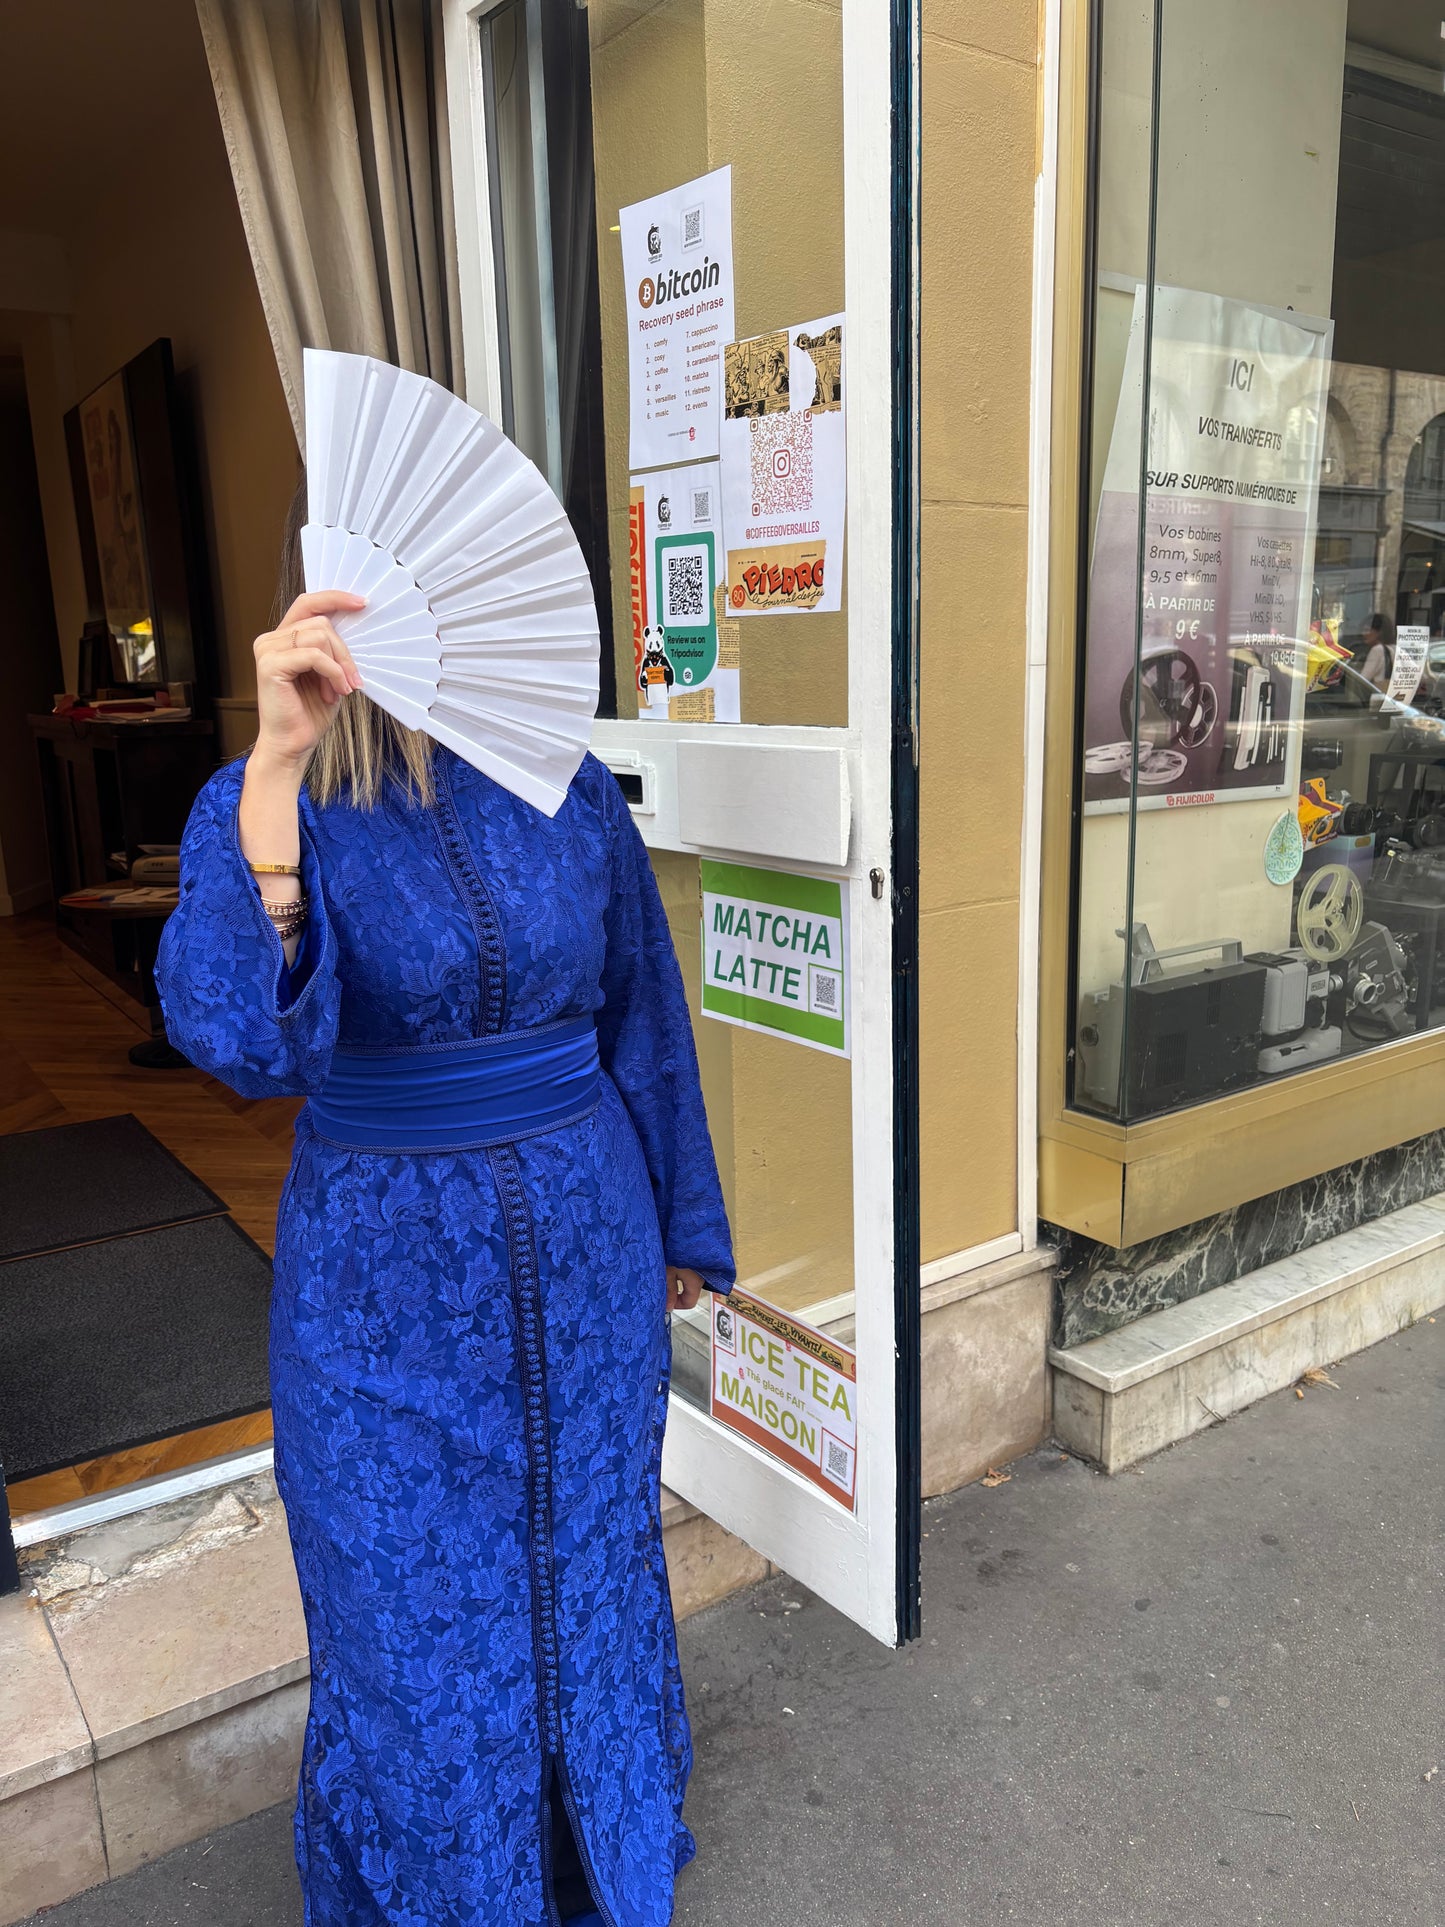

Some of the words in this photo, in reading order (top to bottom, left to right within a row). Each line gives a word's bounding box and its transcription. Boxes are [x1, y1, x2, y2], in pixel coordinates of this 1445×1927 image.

[655, 256, 720, 305] bitcoin
[639, 312, 674, 331] Recovery
[675, 304, 694, 320] seed
[696, 298, 724, 316] phrase
[691, 323, 719, 337] cappuccino
[691, 340, 716, 352] americano
[654, 367, 669, 376] coffee
[691, 371, 709, 381] matcha
[1230, 358, 1255, 392] ICI
[655, 393, 677, 404] versailles
[692, 385, 711, 396] ristretto
[655, 409, 669, 418] music
[692, 400, 708, 410] events
[1198, 416, 1219, 438] VOS
[1220, 421, 1283, 451] TRANSFERTS
[1146, 471, 1179, 488] SUR
[1181, 473, 1235, 495] SUPPORTS
[1235, 481, 1286, 504] NUMÉRIQUES
[1286, 490, 1298, 504] DE
[745, 520, 820, 539] @COFFEEGOVERSAILLES
[1160, 524, 1184, 539] Vos
[1187, 525, 1222, 542] bobines
[1257, 536, 1269, 549] Vos
[1149, 545, 1188, 564] 8mm,
[1150, 570, 1172, 584] 9,5
[1175, 568, 1189, 582] et
[1192, 571, 1218, 583] 16mm
[1145, 592, 1156, 609] À
[1160, 596, 1202, 611] PARTIR
[1203, 598, 1216, 612] DE
[1175, 619, 1186, 640] 9
[1189, 619, 1201, 640] €
[1244, 630, 1251, 646] À
[667, 635, 689, 644] Review
[670, 649, 704, 659] Tripadvisor
[1175, 793, 1215, 806] FUJICOLOR
[713, 902, 832, 959] MATCHA
[713, 949, 802, 1001] LATTE
[741, 1325, 785, 1379] ICE
[793, 1356, 852, 1423] TEA
[746, 1367, 760, 1383] Thé
[762, 1380, 784, 1398] glacé
[786, 1392, 806, 1411] FAIT
[721, 1371, 816, 1455] MAISON
